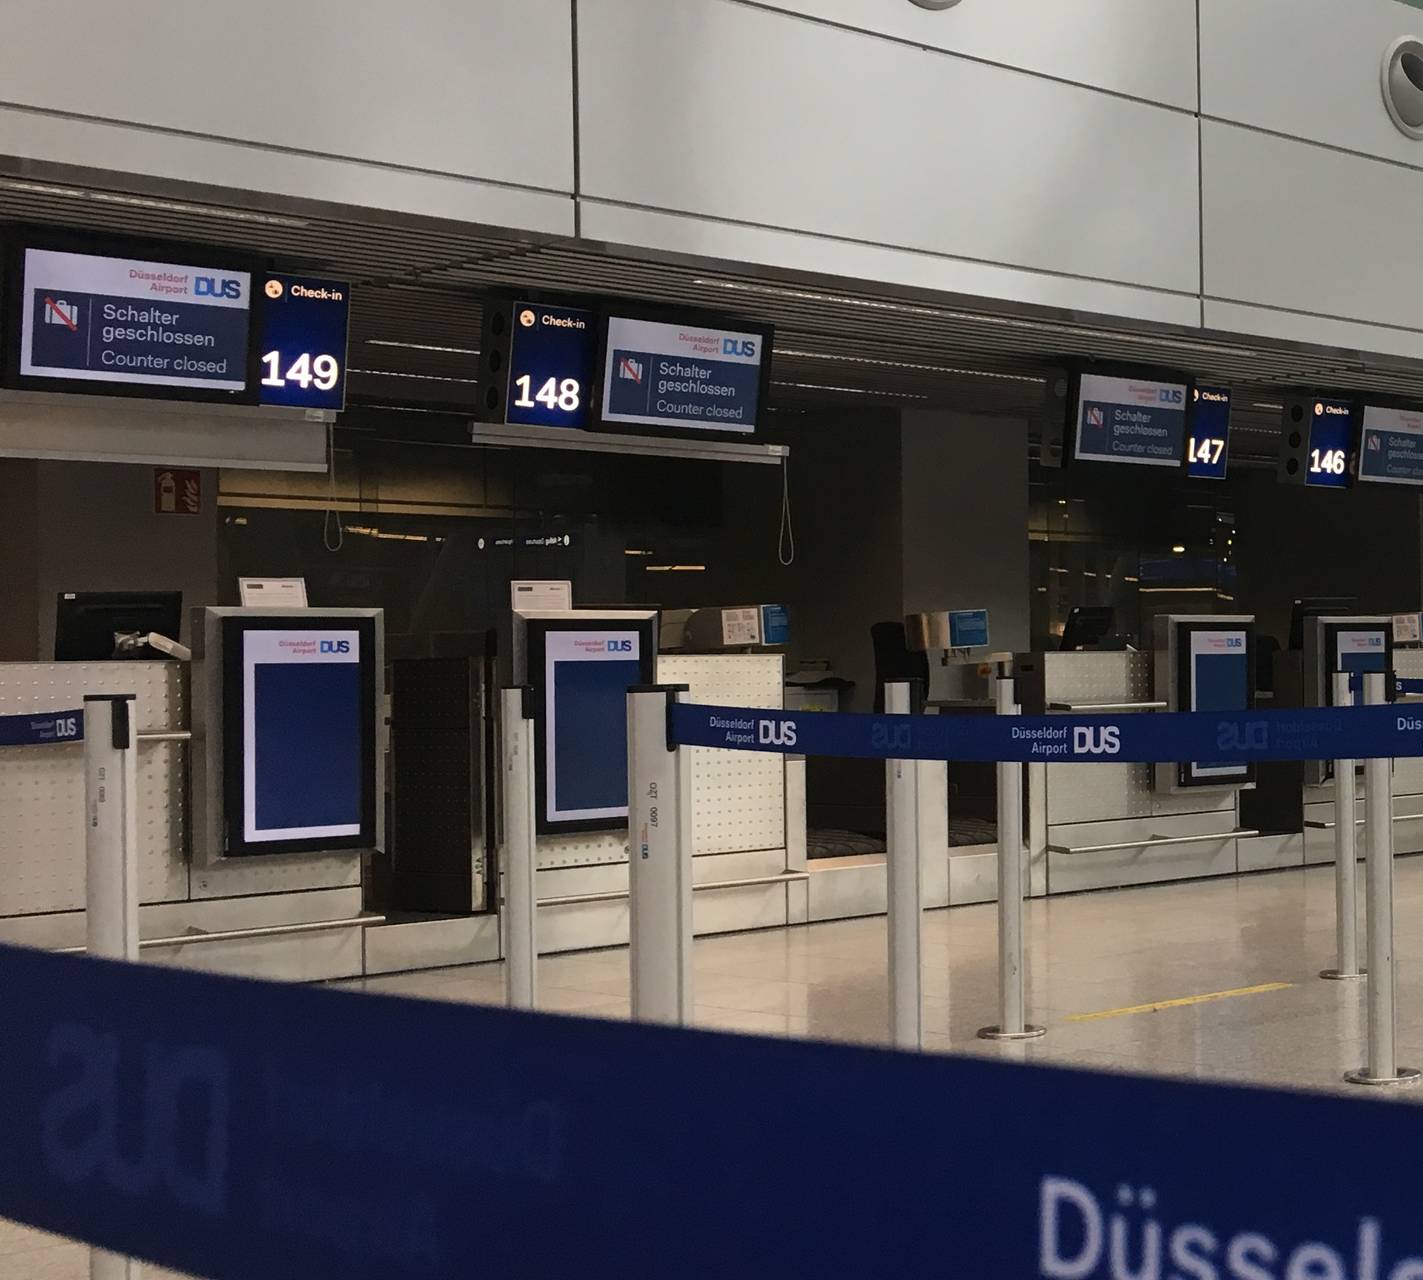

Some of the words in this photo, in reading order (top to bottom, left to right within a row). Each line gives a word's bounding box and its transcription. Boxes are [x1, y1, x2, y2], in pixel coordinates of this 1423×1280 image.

[129, 269, 188, 284] Düsseldorf
[150, 282, 188, 296] Airport
[194, 276, 241, 300] DUS
[291, 284, 342, 301] Check-in
[103, 304, 179, 326] Schalter
[541, 314, 585, 329] Check-in
[102, 324, 215, 348] geschlossen
[723, 338, 756, 358] DUS
[101, 350, 169, 370] Counter
[173, 356, 227, 374] closed
[261, 350, 338, 391] 149
[659, 361, 712, 380] Schalter
[514, 375, 579, 412] 148
[658, 378, 736, 398] geschlossen
[1159, 389, 1183, 404] DUS
[1202, 391, 1228, 402] Check-in
[656, 399, 703, 417] Counter
[705, 404, 743, 420] closed
[1114, 409, 1151, 423] Schalter
[1113, 424, 1168, 438] geschlossen
[1112, 440, 1145, 453] Counter
[1310, 449, 1346, 475] 146
[320, 640, 350, 653] DUS
[607, 640, 632, 651] DUS
[56, 718, 76, 736] DUS
[710, 715, 755, 730] Düsseldorf
[726, 731, 755, 744] Airport
[759, 719, 797, 746] DUS
[1012, 727, 1068, 740] Düsseldorf
[1073, 726, 1120, 754] DUS
[1031, 741, 1068, 756] Airport
